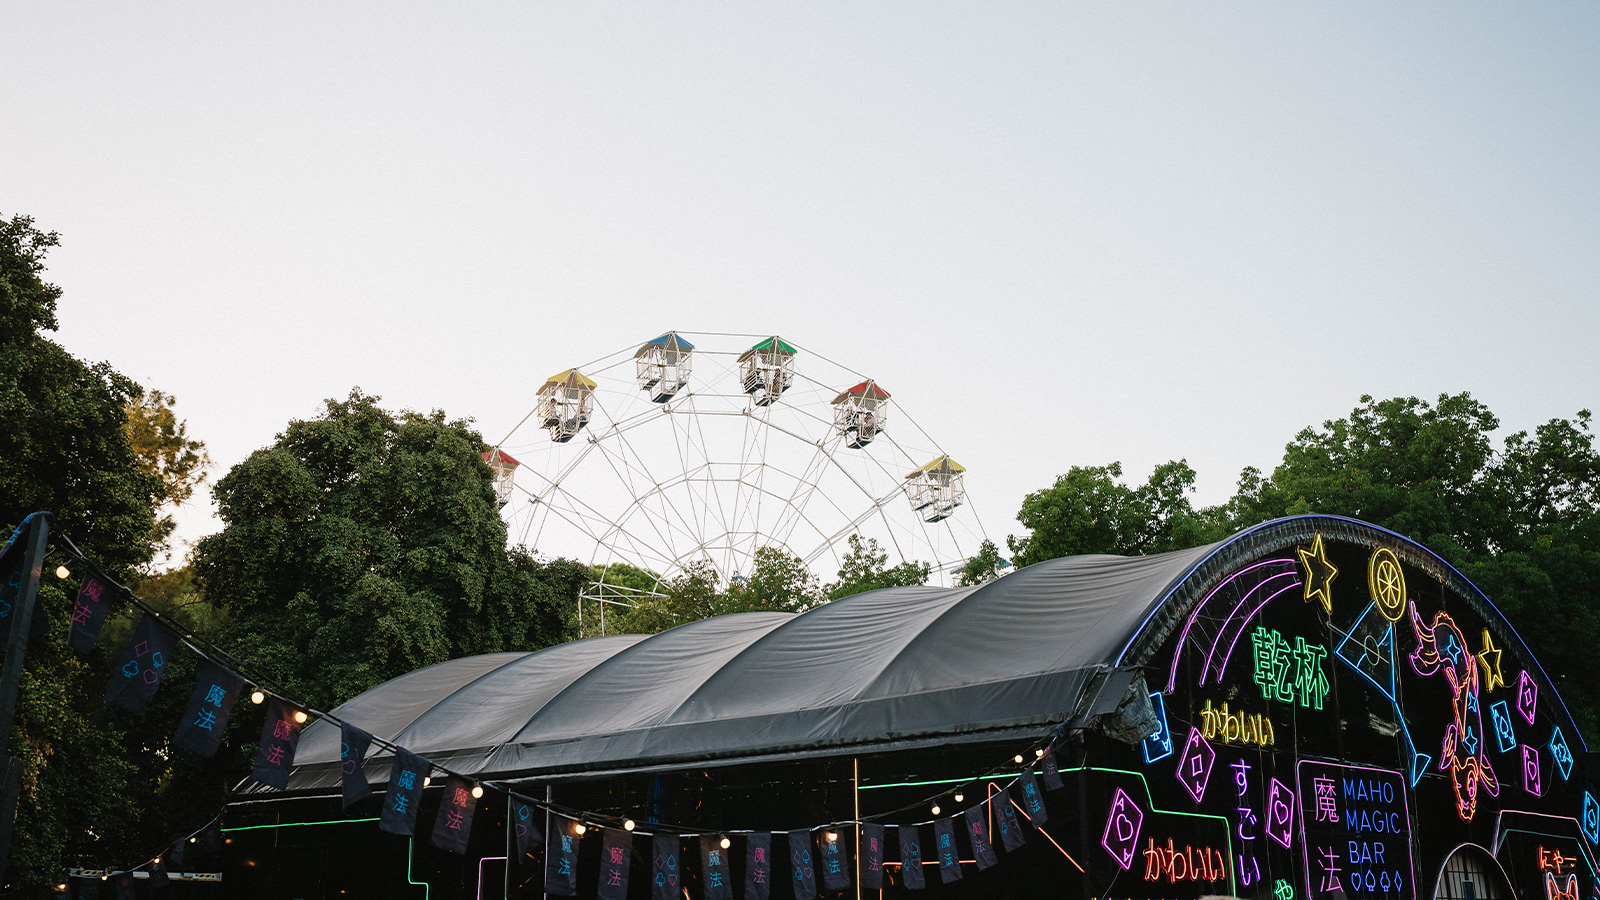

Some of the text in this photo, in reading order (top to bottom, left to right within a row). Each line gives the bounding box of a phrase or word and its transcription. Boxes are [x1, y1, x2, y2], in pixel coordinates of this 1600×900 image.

[73, 578, 104, 626] 魔法
[1251, 625, 1330, 712] 乾杯
[194, 684, 227, 732] 魔法
[1200, 698, 1275, 747] かわいい
[266, 719, 292, 767] 魔法
[392, 769, 417, 814] 魔法
[445, 787, 469, 831] 魔法
[1342, 777, 1394, 804] MAHO
[1313, 773, 1344, 893] 魔法
[1345, 808, 1401, 834] MAGIC
[558, 834, 573, 876] 魔法
[608, 847, 624, 887] 魔法
[708, 850, 723, 888] 魔法
[753, 847, 765, 884] 魔法
[940, 833, 953, 866] 魔法
[1143, 836, 1226, 884] かわいい
[1348, 840, 1385, 864] BAR
